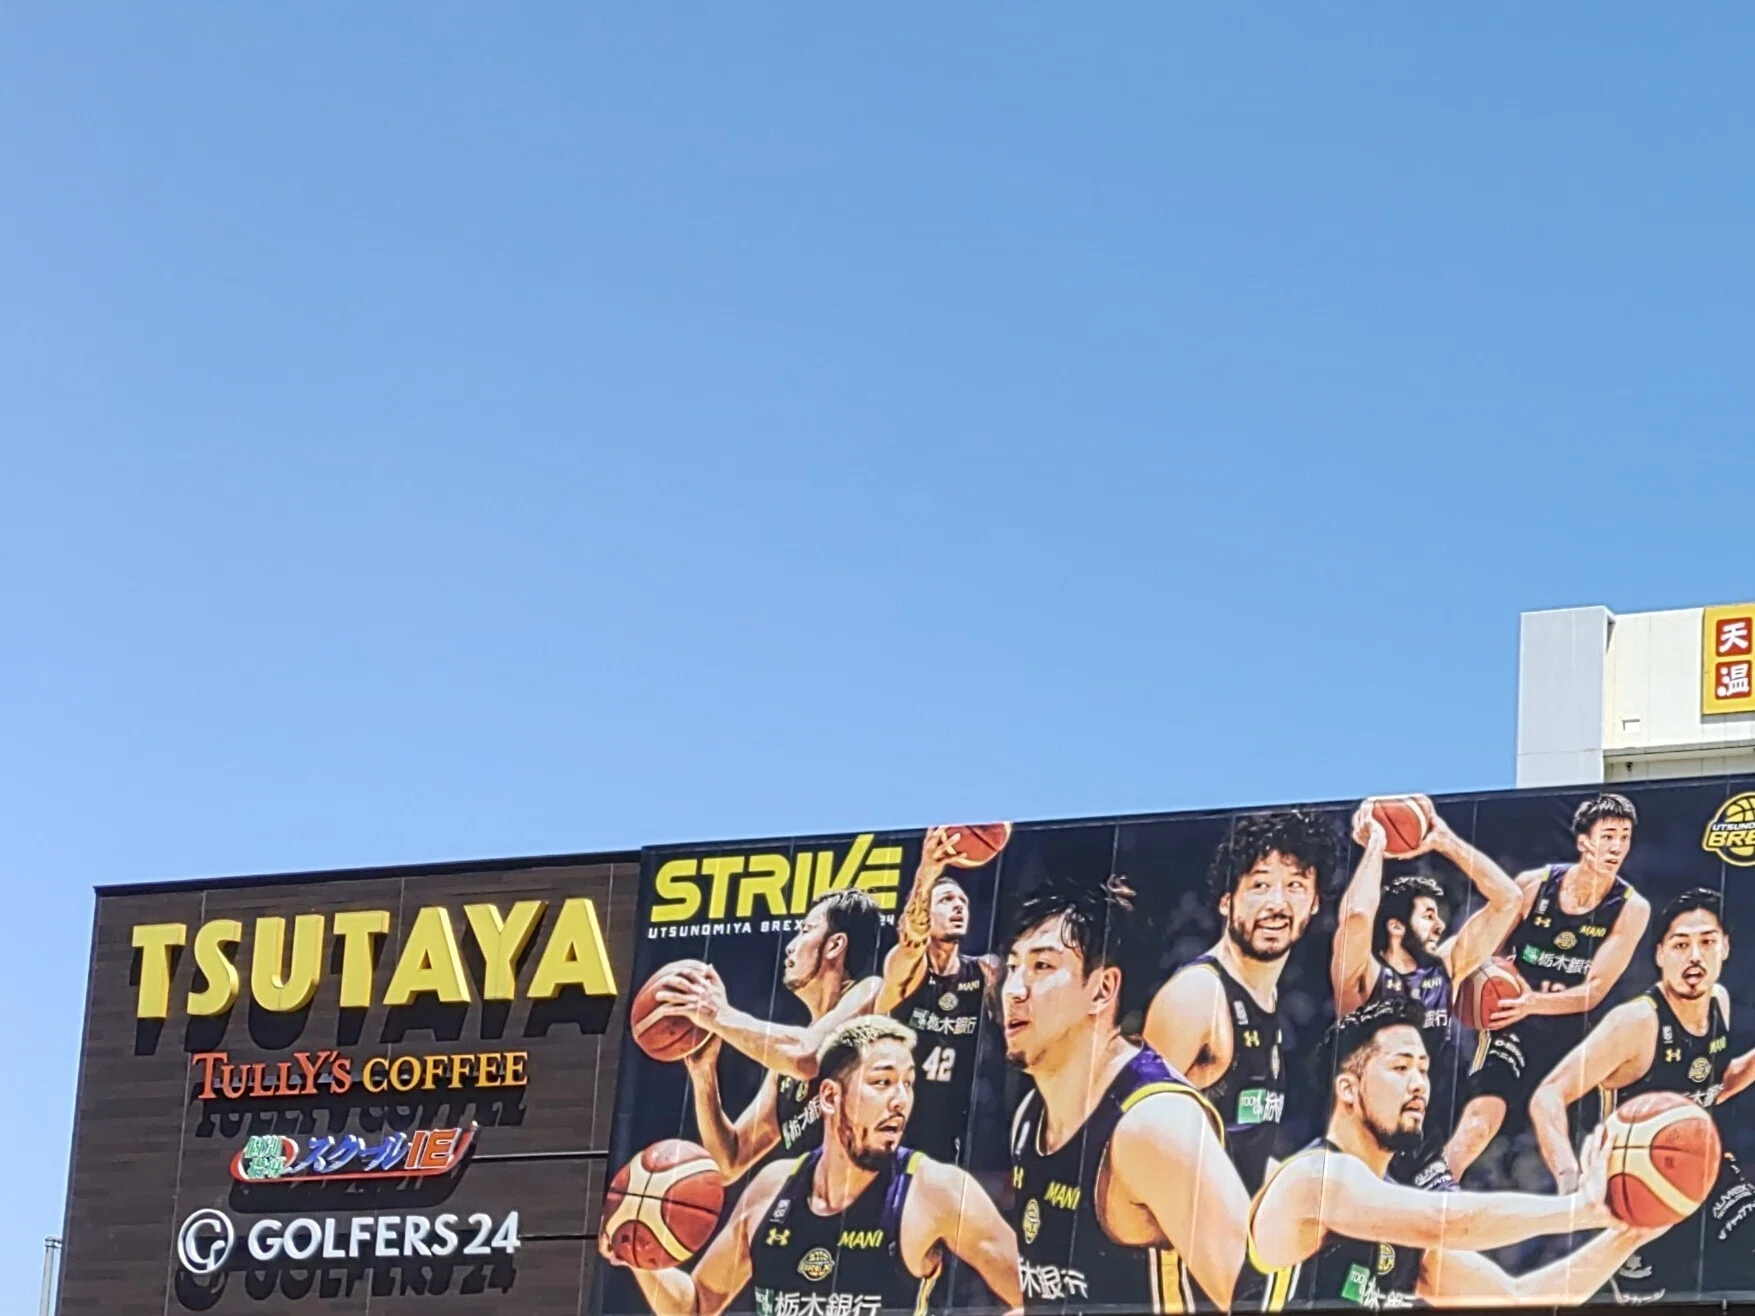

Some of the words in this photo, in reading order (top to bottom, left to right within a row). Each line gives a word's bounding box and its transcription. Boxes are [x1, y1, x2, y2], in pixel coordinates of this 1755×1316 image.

[651, 834, 902, 922] STRIVE
[649, 923, 751, 938] UTSUNOMIYA
[761, 917, 803, 932] BREX
[132, 897, 618, 1019] TSUTAYA
[363, 1051, 528, 1092] COFFEE
[922, 1046, 956, 1082] 42
[838, 1229, 884, 1249] MANI
